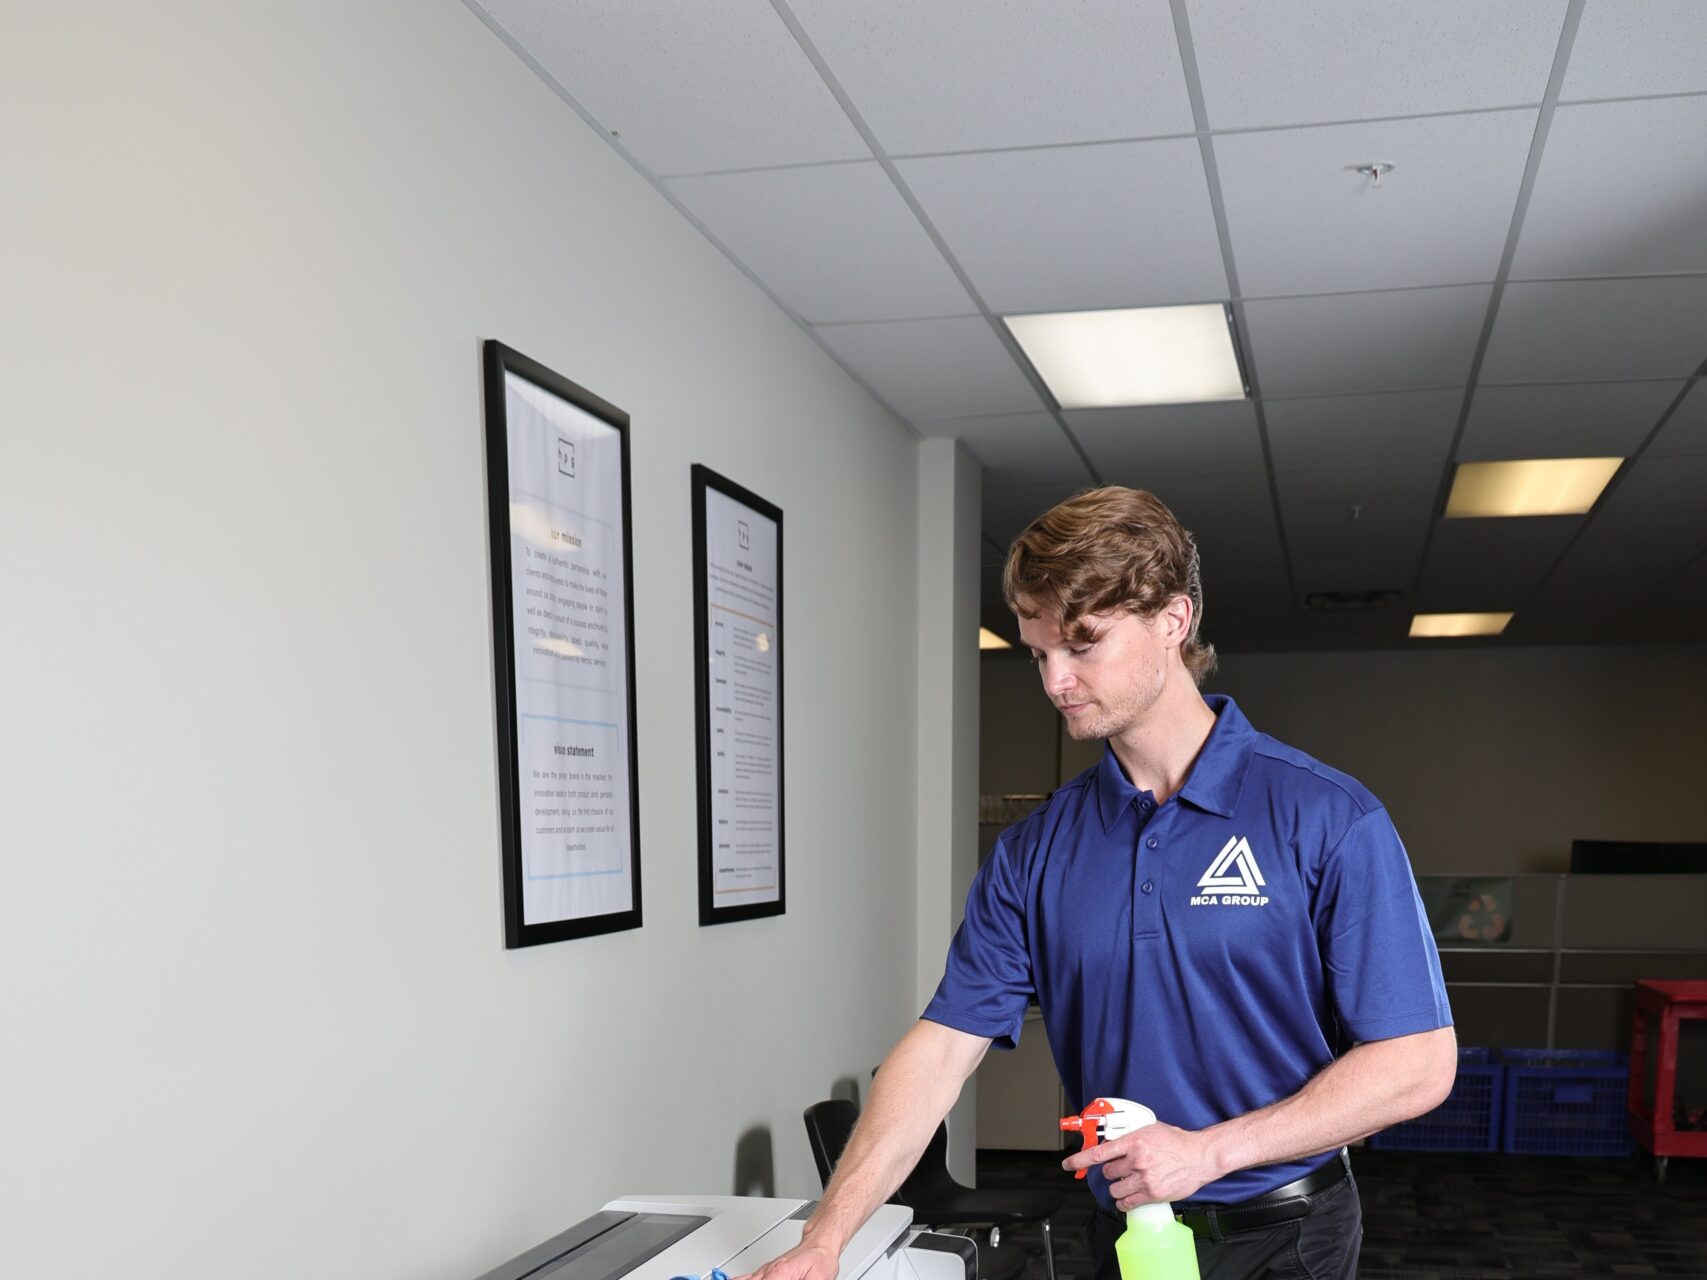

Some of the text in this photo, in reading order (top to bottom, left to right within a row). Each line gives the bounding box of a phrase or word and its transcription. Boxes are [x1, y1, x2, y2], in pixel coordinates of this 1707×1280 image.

[561, 531, 582, 548] mission
[567, 744, 594, 757] statement
[1190, 895, 1269, 906] MCA GROUP
